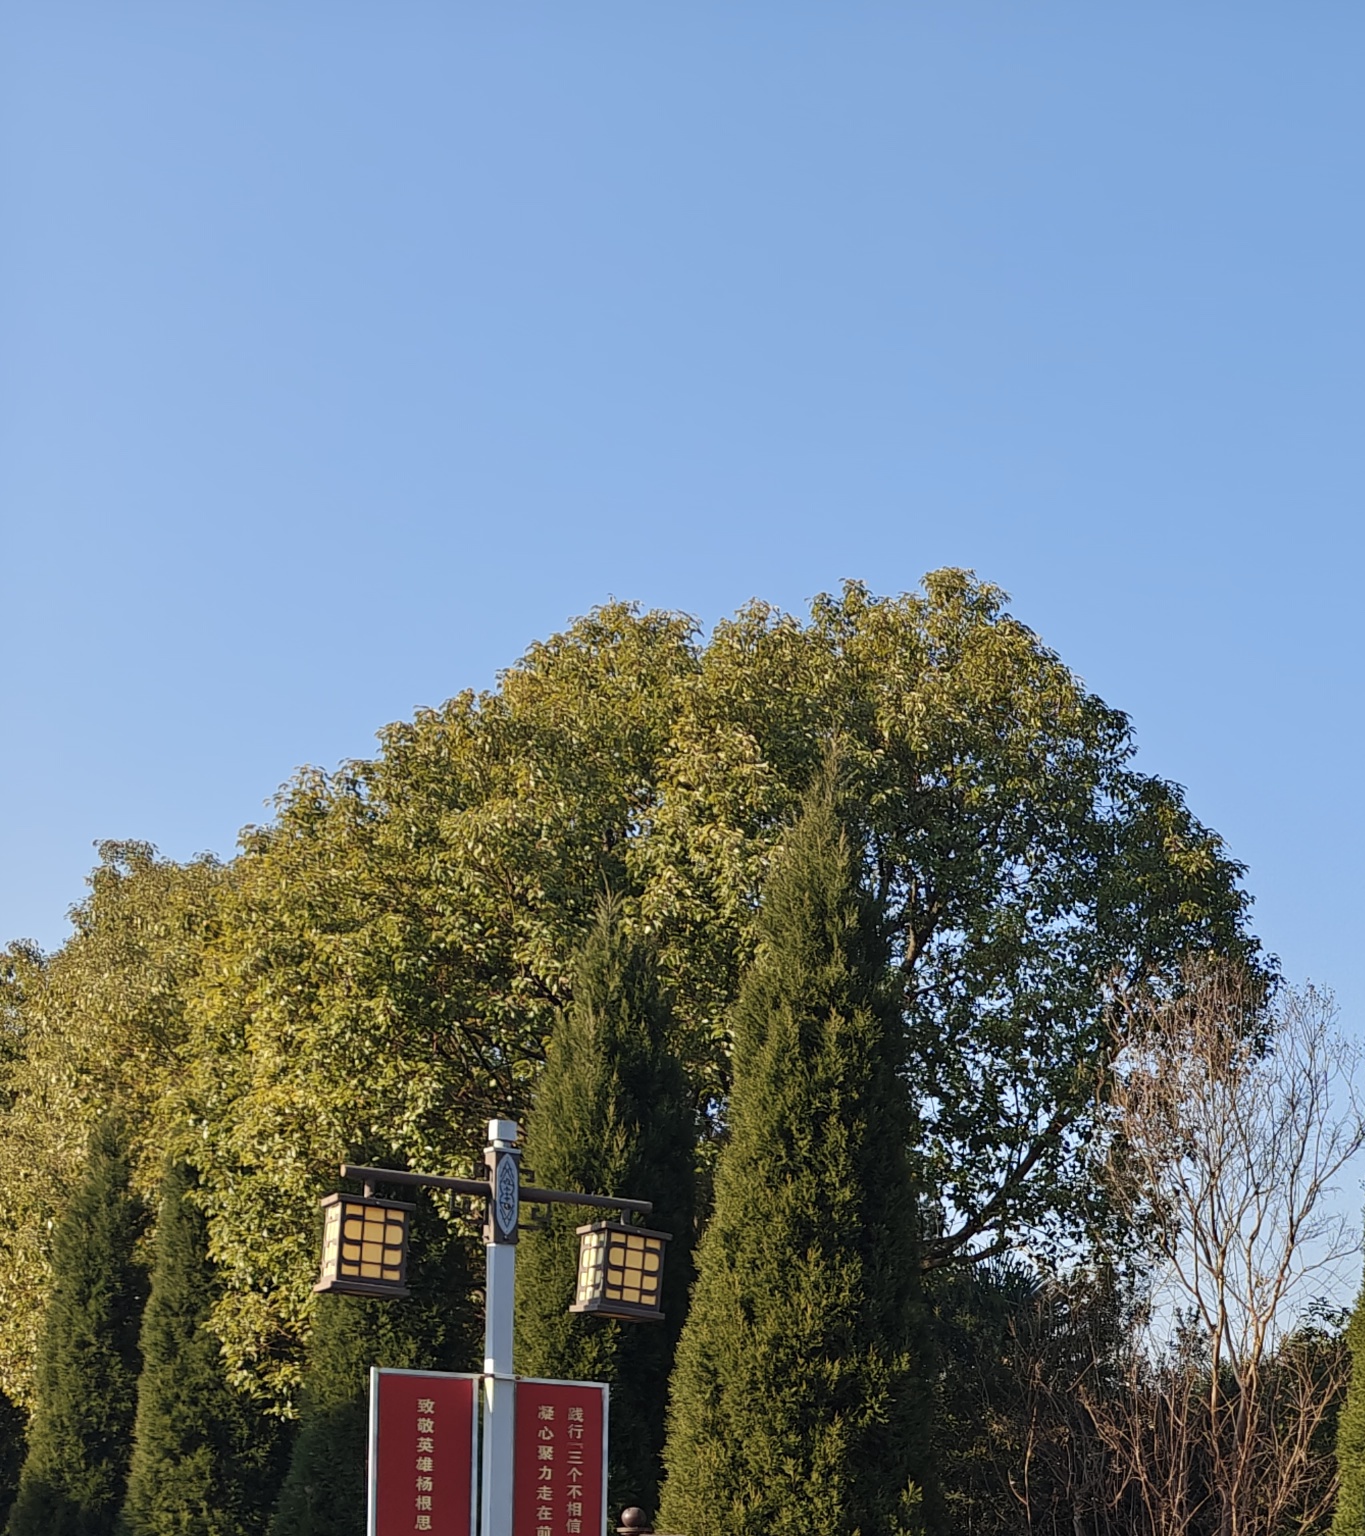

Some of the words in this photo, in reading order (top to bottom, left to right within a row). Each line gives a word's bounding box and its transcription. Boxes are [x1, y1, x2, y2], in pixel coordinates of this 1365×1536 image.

[415, 1398, 436, 1531] 致敬英雄杨根思
